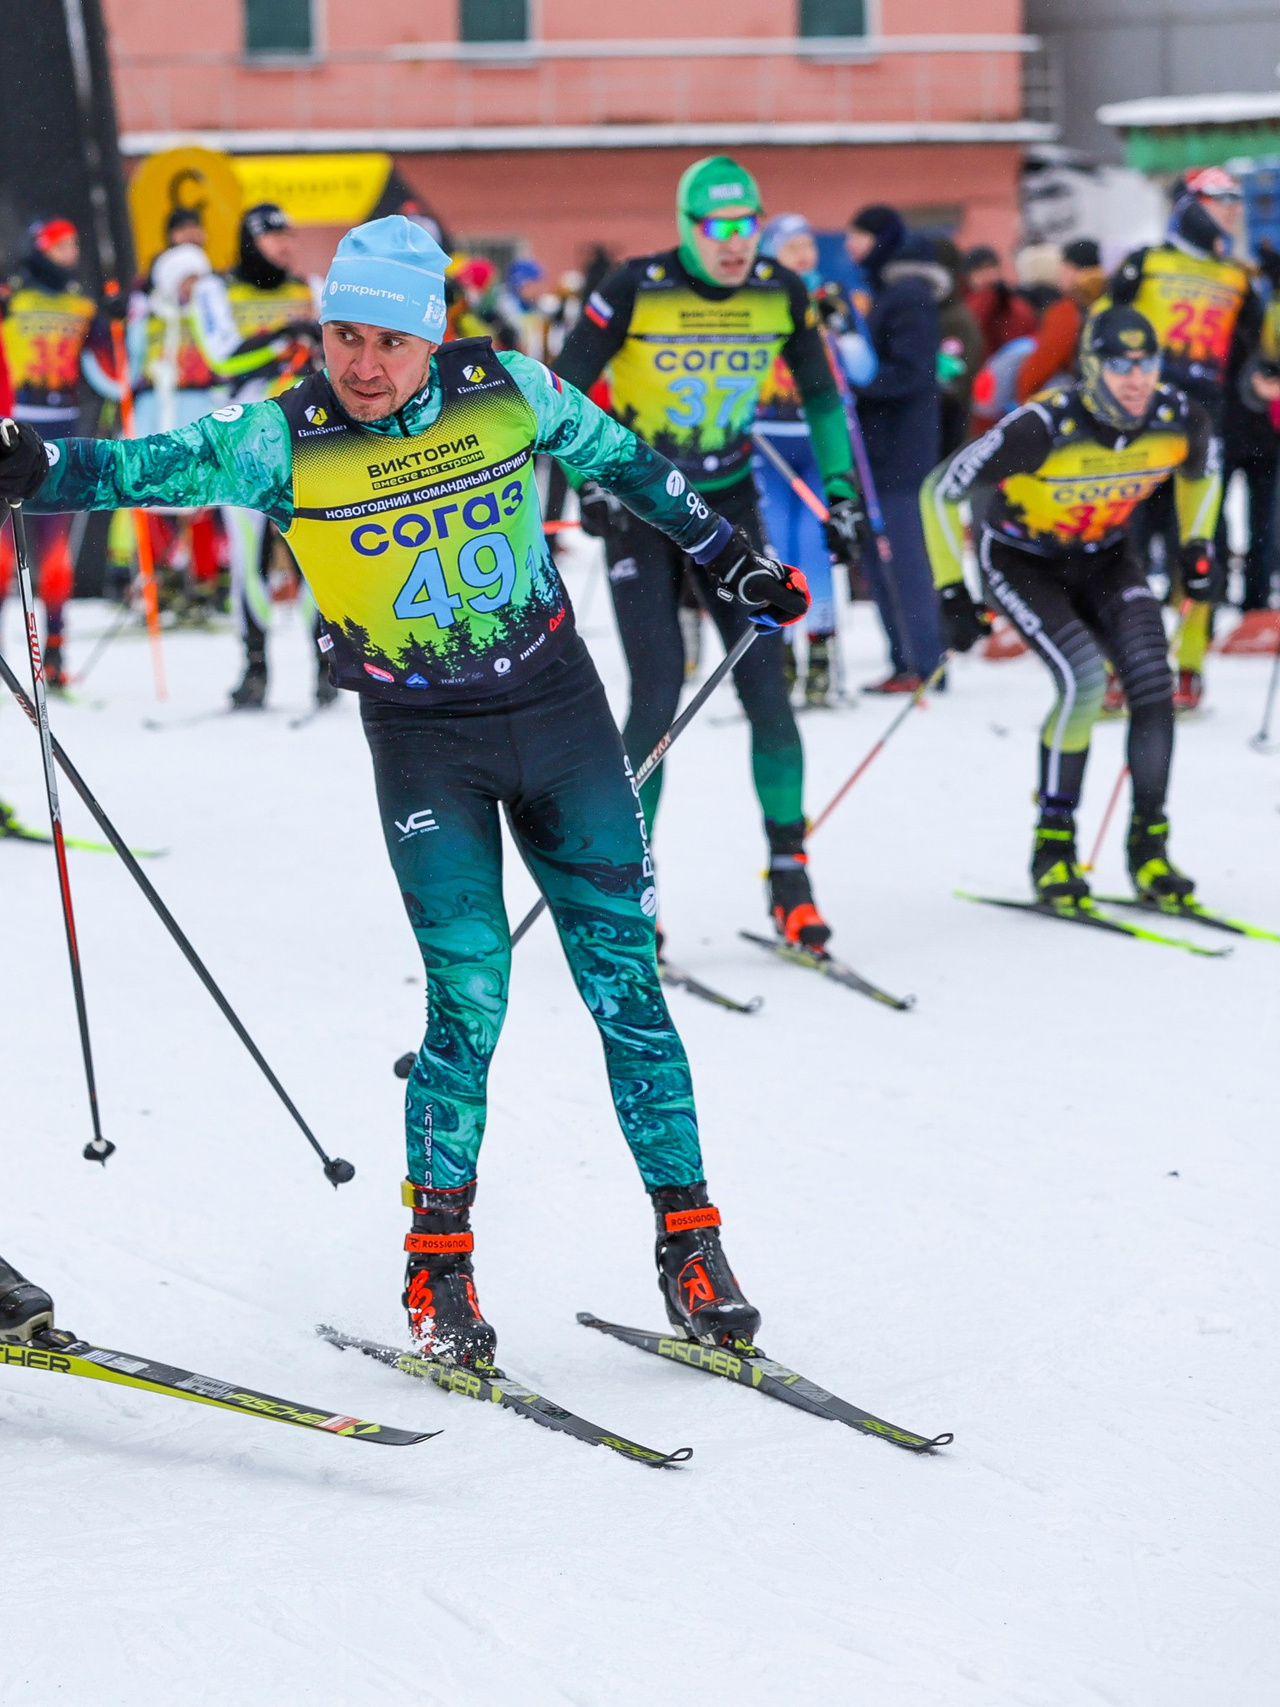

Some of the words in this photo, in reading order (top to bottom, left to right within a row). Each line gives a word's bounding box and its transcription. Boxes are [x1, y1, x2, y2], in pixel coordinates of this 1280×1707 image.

[339, 284, 405, 302] открытие
[654, 349, 770, 373] согаз
[665, 375, 758, 428] 37
[367, 433, 480, 478] ВИКТОРИЯ
[372, 472, 419, 490] вместе
[421, 465, 439, 478] мы
[441, 450, 484, 470] строим
[325, 493, 412, 519] НОВОГОДНИЙ
[413, 469, 491, 502] КОМАНДНЫЙ
[492, 450, 527, 478] СПРИНТ
[350, 480, 524, 556] согаз
[393, 531, 516, 629] 49
[394, 808, 436, 834] VC
[424, 1103, 433, 1166] VICTORY
[670, 1213, 717, 1227] ROSSIGNOL
[422, 1239, 468, 1249] ROSSIGNOL
[657, 1337, 742, 1380] FISCHER
